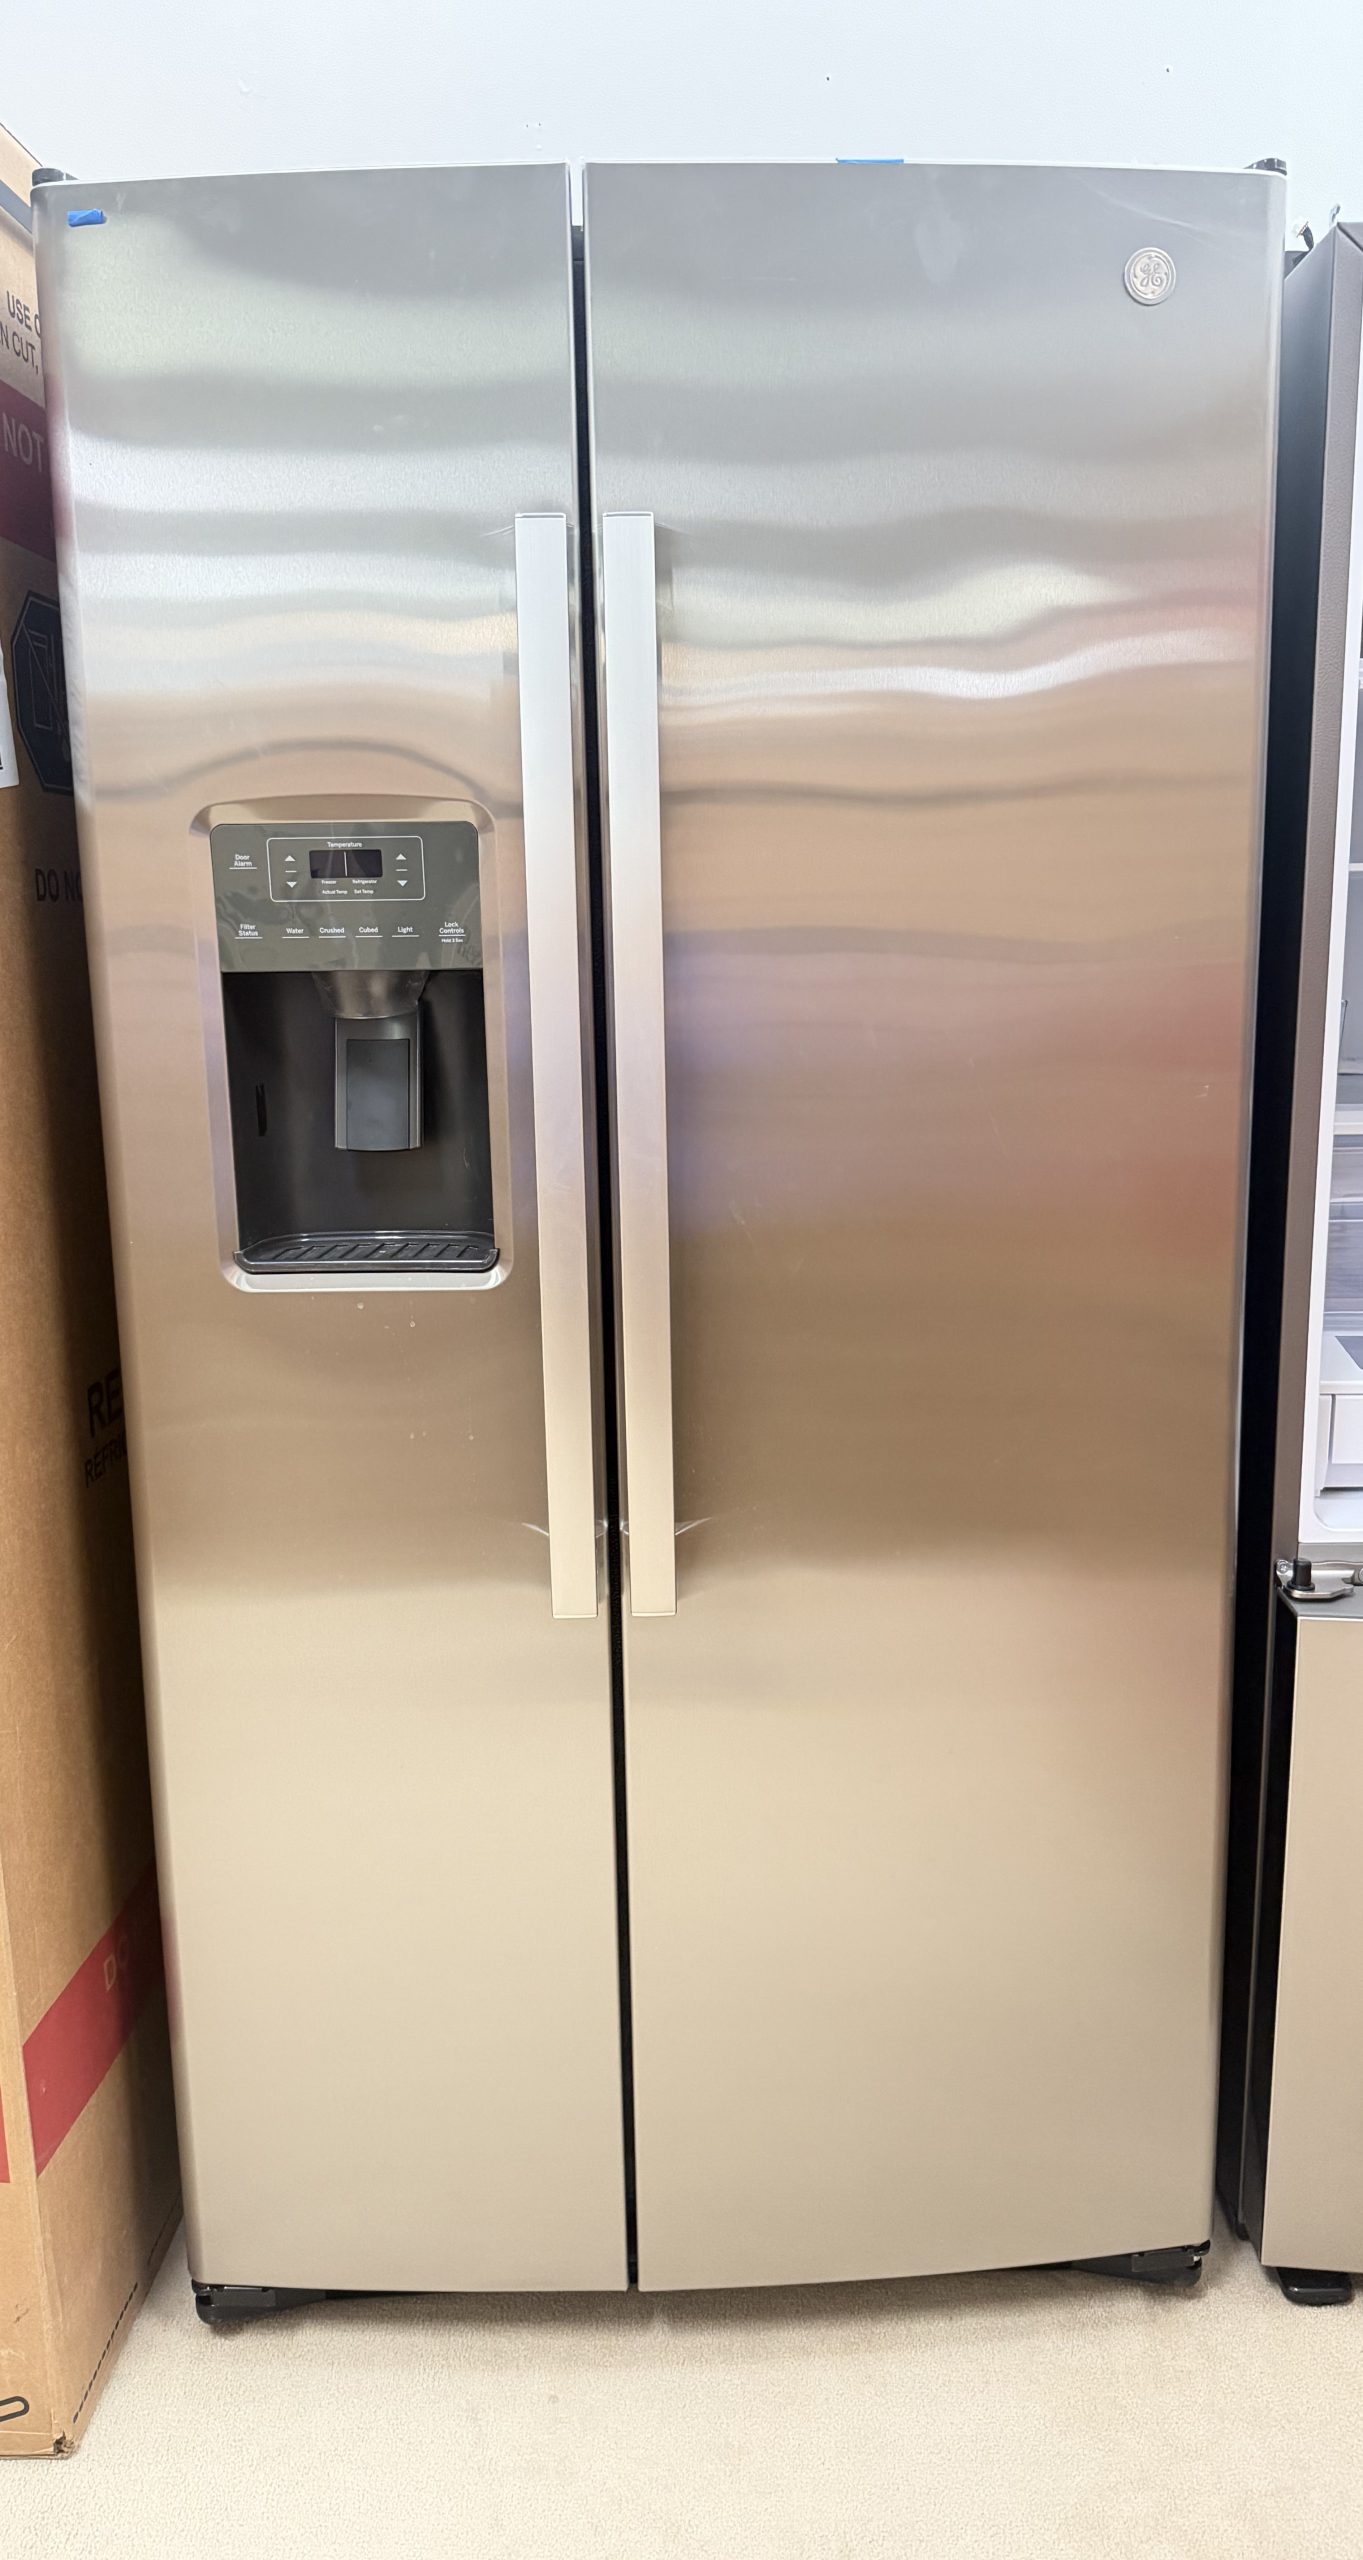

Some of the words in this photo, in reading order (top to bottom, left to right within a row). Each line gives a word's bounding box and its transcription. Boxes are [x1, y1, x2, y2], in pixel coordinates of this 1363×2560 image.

[6, 290, 32, 332] USE
[12, 331, 39, 375] CUT,
[2, 411, 44, 473] NOT
[35, 868, 60, 902] DO
[397, 925, 414, 933] Light
